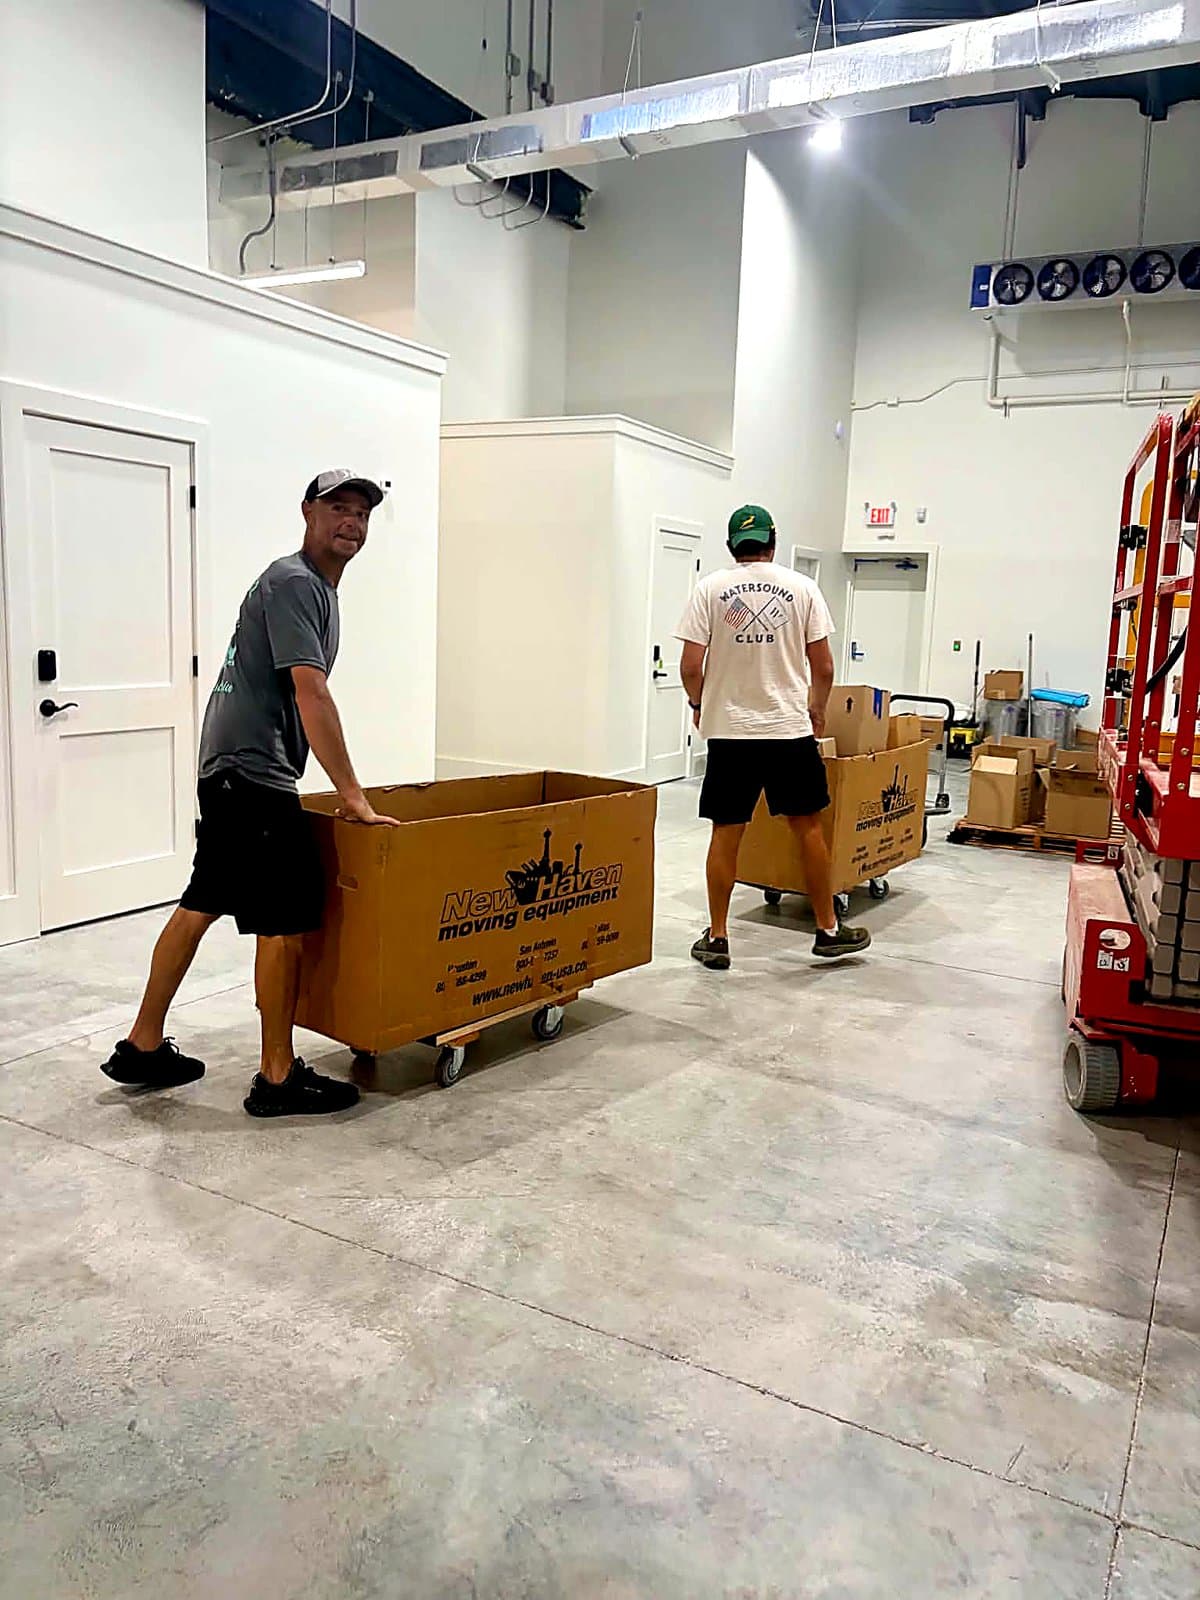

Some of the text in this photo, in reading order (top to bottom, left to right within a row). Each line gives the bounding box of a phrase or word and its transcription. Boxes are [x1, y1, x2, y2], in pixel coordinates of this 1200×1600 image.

[871, 508, 890, 523] EXIT
[720, 583, 794, 602] WATERSOUND
[736, 634, 774, 643] CLUB
[440, 863, 623, 924] New Haven
[438, 885, 619, 942] moving equipment
